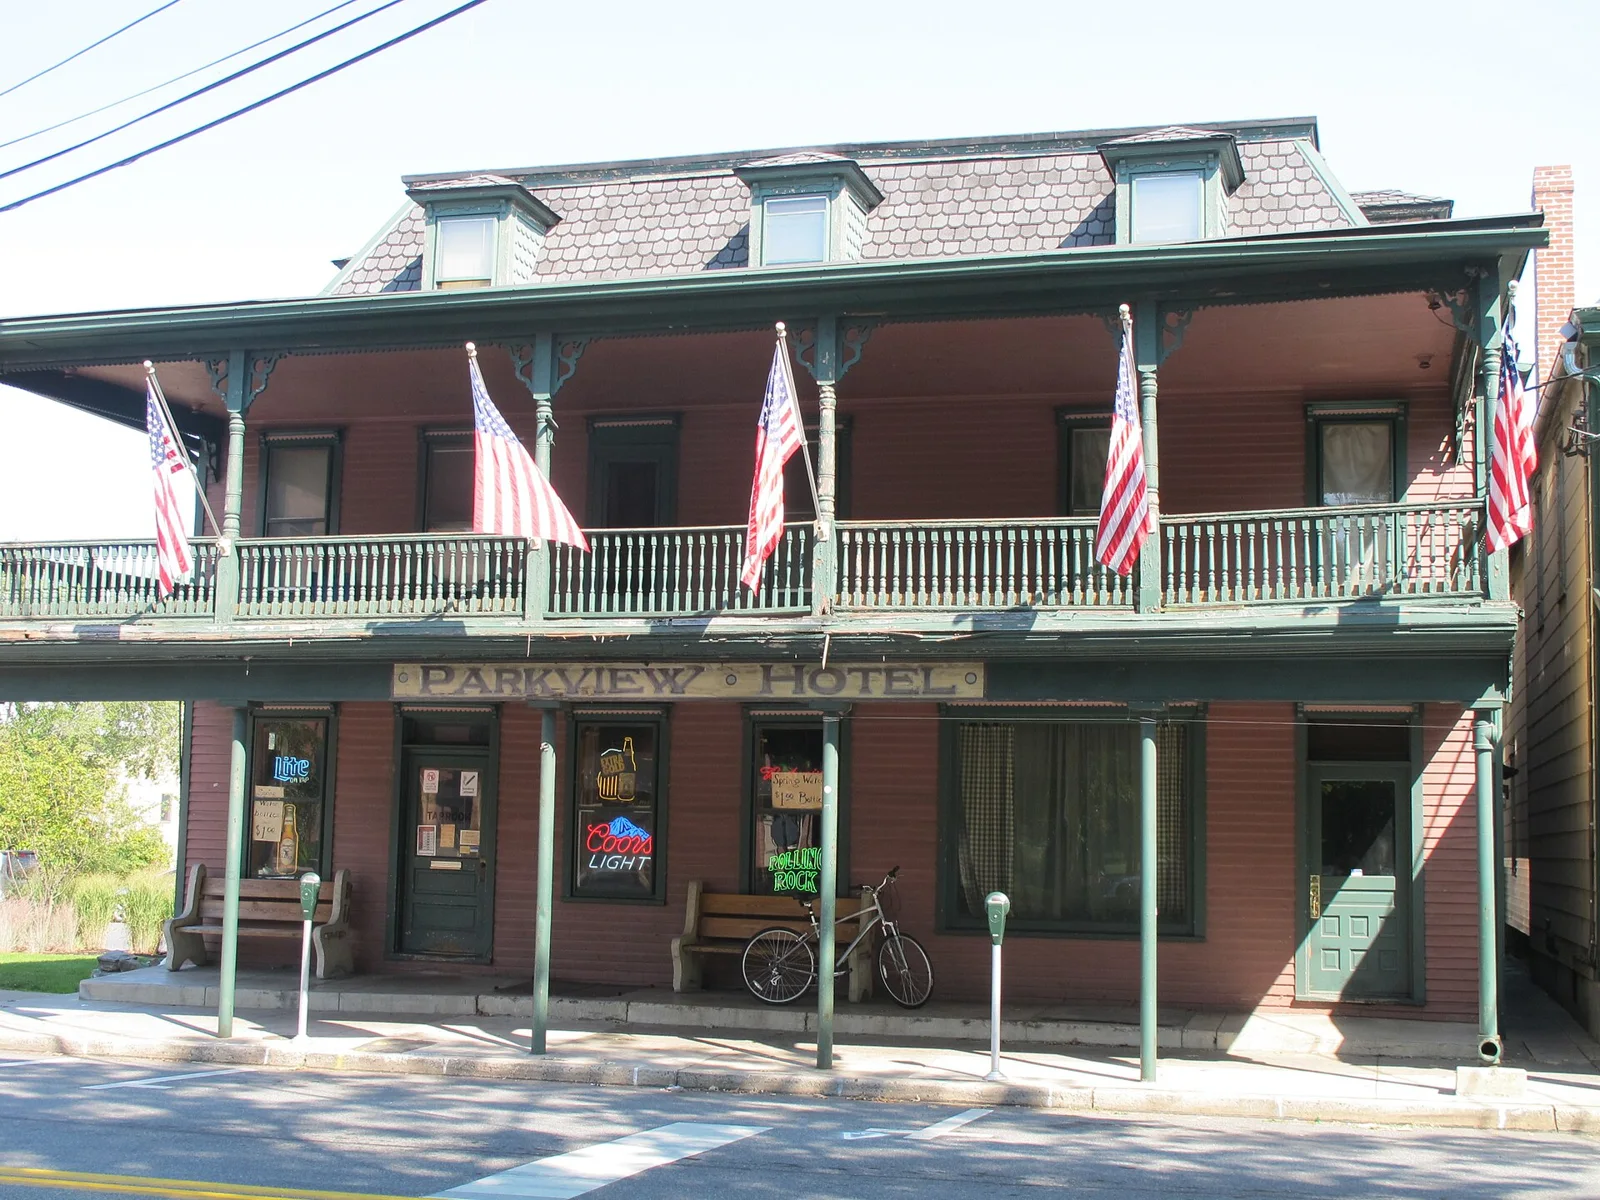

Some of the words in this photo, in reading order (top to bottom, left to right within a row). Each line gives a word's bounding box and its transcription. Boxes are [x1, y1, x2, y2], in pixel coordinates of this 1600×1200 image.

[420, 665, 704, 694] PARKVIEW
[760, 664, 956, 695] HOTEL
[273, 756, 310, 782] Lite
[587, 823, 652, 855] Coors
[588, 854, 652, 871] LIGHT
[774, 870, 817, 893] ROCK
